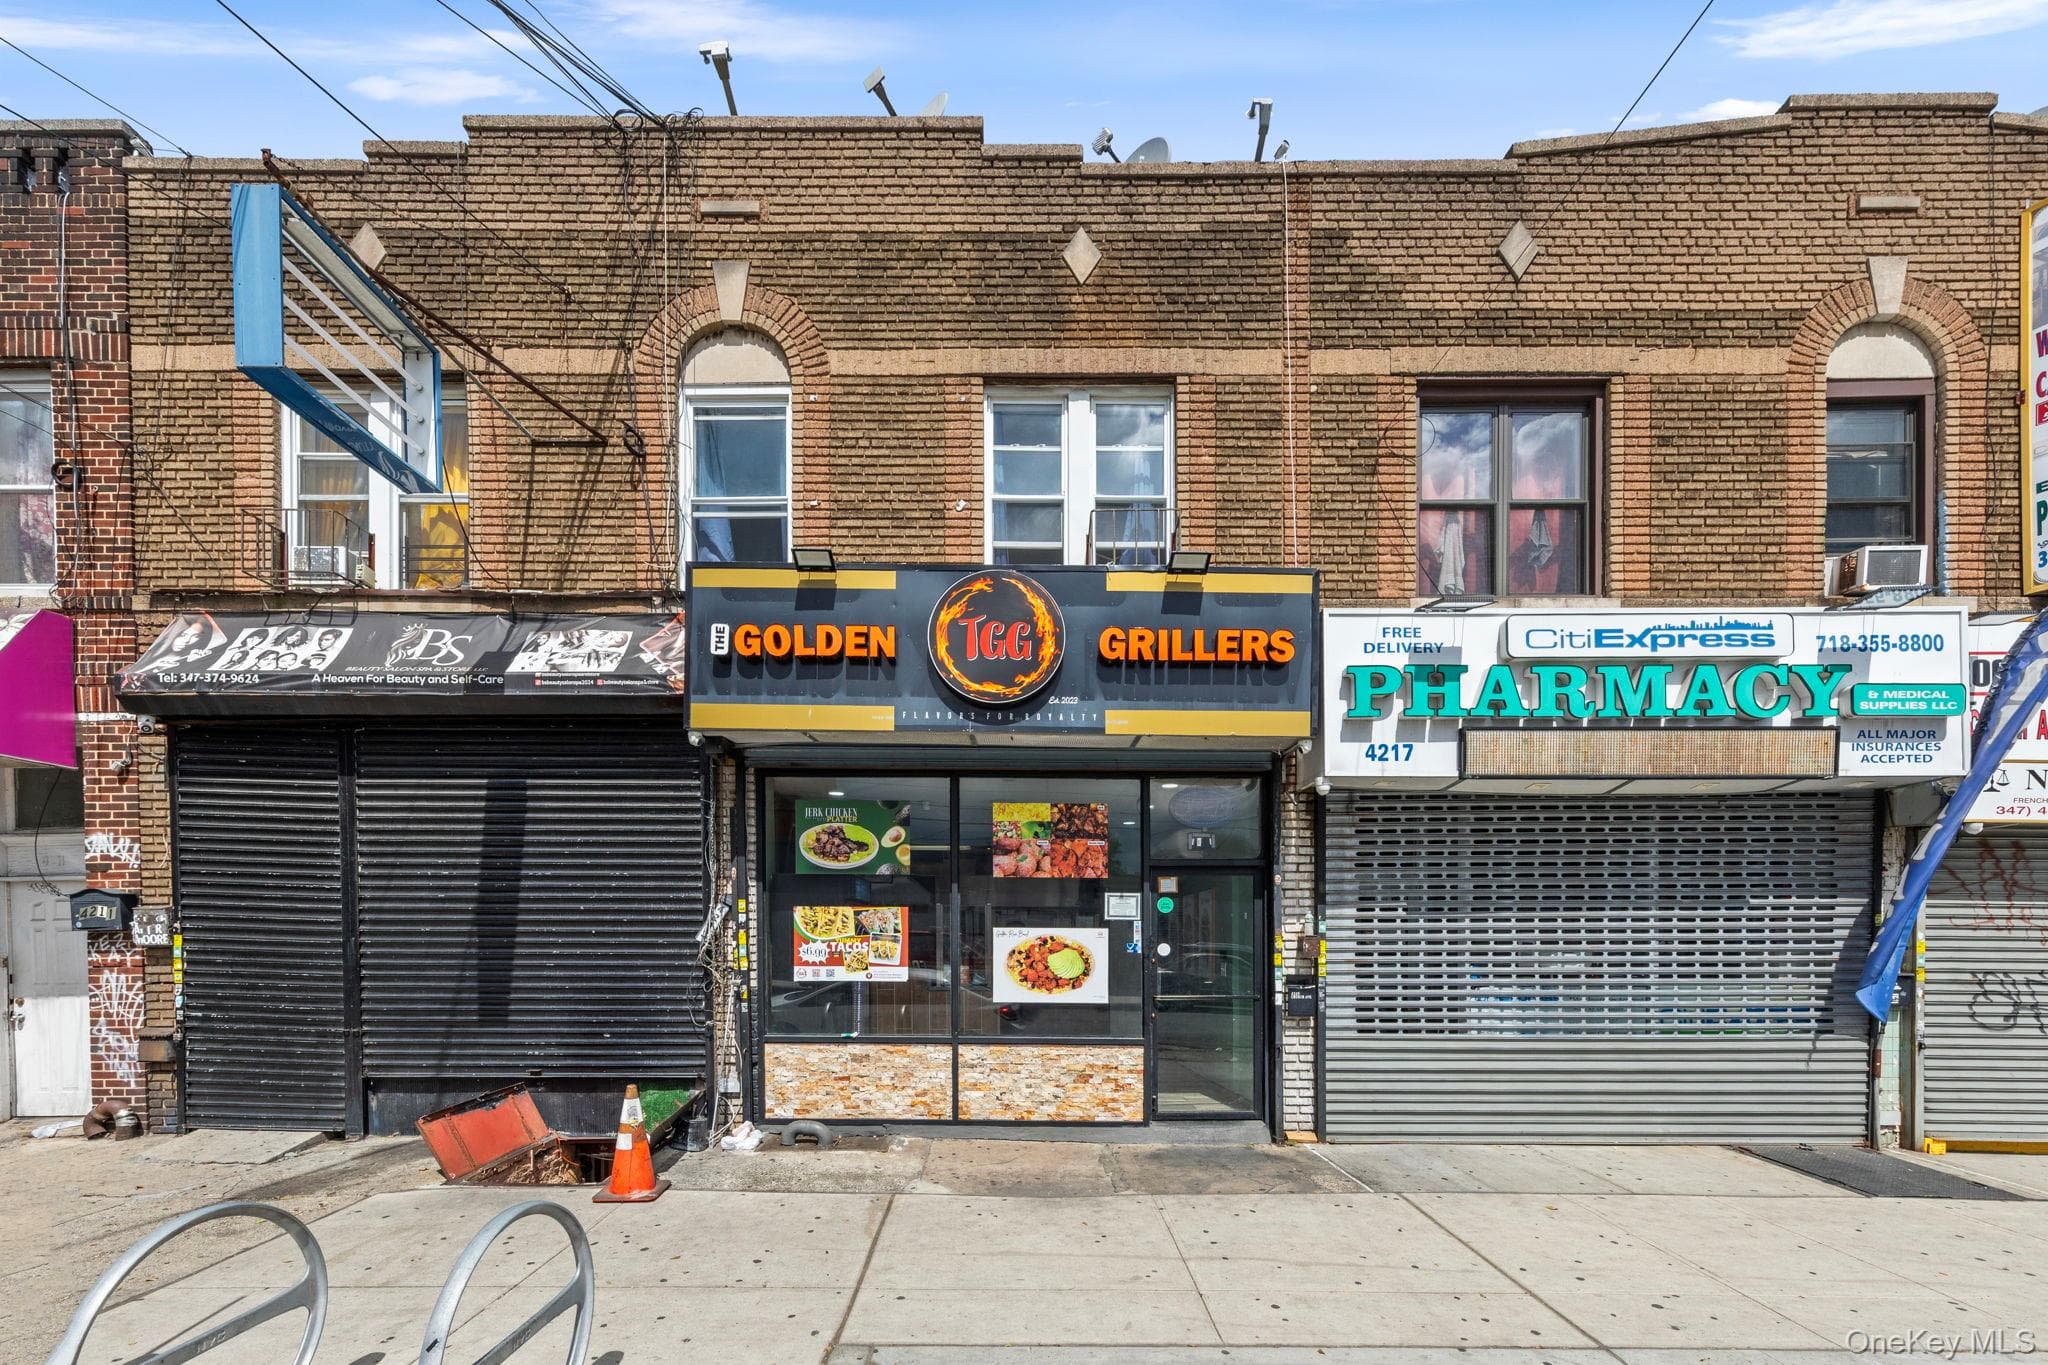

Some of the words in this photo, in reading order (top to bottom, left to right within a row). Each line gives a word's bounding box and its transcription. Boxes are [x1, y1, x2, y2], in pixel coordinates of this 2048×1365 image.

[957, 614, 1032, 661] TGG
[1382, 627, 1422, 638] FREE
[715, 625, 726, 652] THE
[733, 623, 896, 658] GOLDEN
[1099, 625, 1296, 663] GRILLERS
[1525, 627, 1776, 652] CitiExpress
[1815, 634, 1944, 653] 718-355-8800
[404, 628, 473, 666] BS
[1363, 642, 1444, 654] DELIVERY
[157, 672, 178, 683] Tel:
[179, 673, 260, 684] 347-374-9624
[311, 674, 321, 683] A
[322, 674, 364, 683] Heaven
[366, 674, 385, 683] For
[386, 674, 426, 686] Beauty
[427, 674, 449, 683] and
[451, 674, 504, 684] Self-Care
[1346, 663, 1852, 718] PHARMACY
[1867, 690, 1880, 699] &
[1883, 690, 1950, 699] MEDICAL
[1061, 696, 1079, 704] 2023
[1859, 701, 1928, 710] SUPPLIES
[1931, 701, 1958, 710] LLC
[902, 711, 975, 720] FLAVORS
[986, 712, 1014, 720] FOR
[1025, 713, 1097, 721] ROYALTY
[1857, 729, 1883, 739] ALL
[1886, 729, 1937, 739] MAJOR
[1365, 743, 1415, 762] 4217
[1851, 742, 1942, 752] INSURANCES
[1860, 754, 1933, 763] ACCEPTED
[805, 807, 823, 818] JERK
[825, 807, 858, 817] CHICKEN
[79, 905, 115, 920] 4211
[802, 945, 827, 958] $6.99
[830, 941, 869, 952] TACOS
